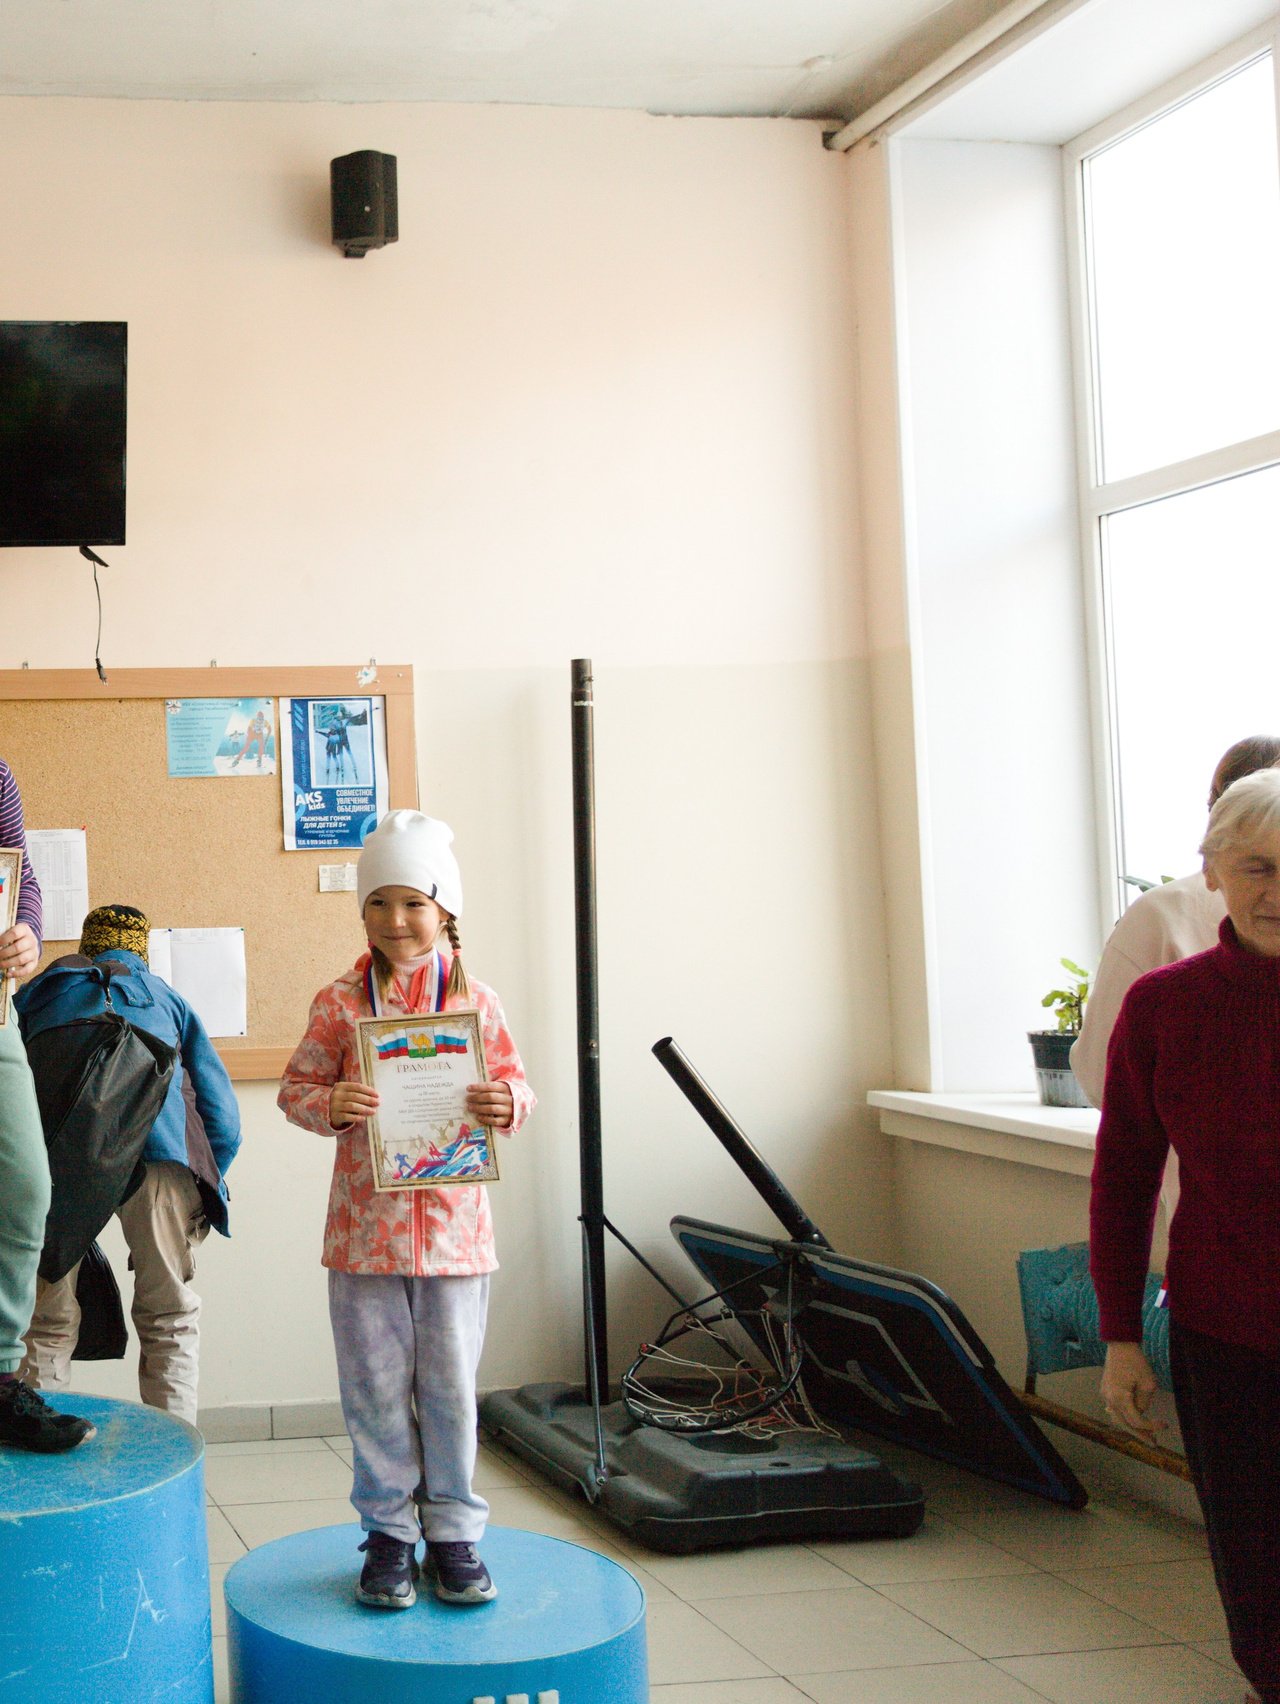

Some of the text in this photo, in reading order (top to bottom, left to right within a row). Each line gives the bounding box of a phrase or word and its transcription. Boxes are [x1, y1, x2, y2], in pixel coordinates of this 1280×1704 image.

[336, 789, 373, 797] СОВМЕСТНОЕ
[296, 791, 323, 806] AKS
[336, 797, 369, 805] УВЛЕЧЕНИЕ
[308, 803, 326, 811] kids
[396, 1061, 452, 1073] ГРАМОТА
